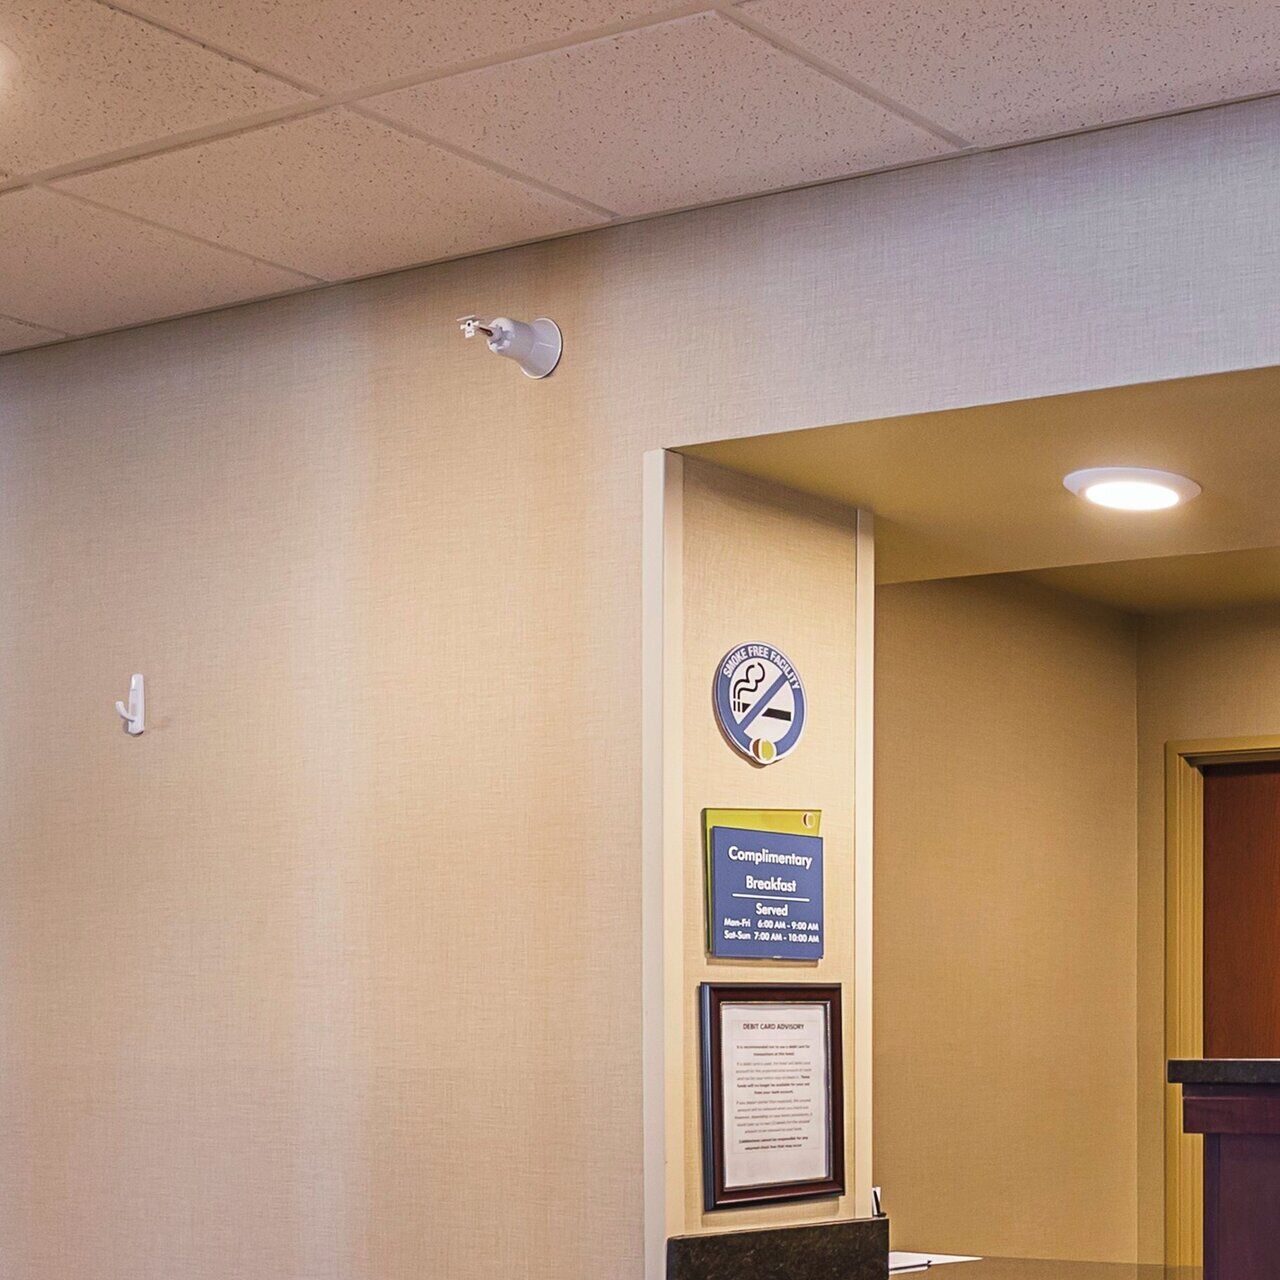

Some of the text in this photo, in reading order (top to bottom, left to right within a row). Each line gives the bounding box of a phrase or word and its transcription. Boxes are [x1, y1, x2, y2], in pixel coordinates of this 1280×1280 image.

[723, 645, 800, 689] SMOKE FREE FACILITY
[728, 846, 813, 870] Complimentary
[745, 875, 797, 893] Breakfast
[755, 902, 789, 917] Served
[723, 917, 751, 928] Mon-Fri
[757, 919, 774, 929] 6:00
[774, 920, 787, 930] AM
[791, 921, 807, 931] 9:00
[807, 922, 819, 932] AM
[723, 929, 752, 940] Sat-Sun
[754, 931, 770, 941] 7:00
[770, 932, 783, 942] AM
[788, 933, 807, 943] 10:00
[807, 934, 820, 943] AM
